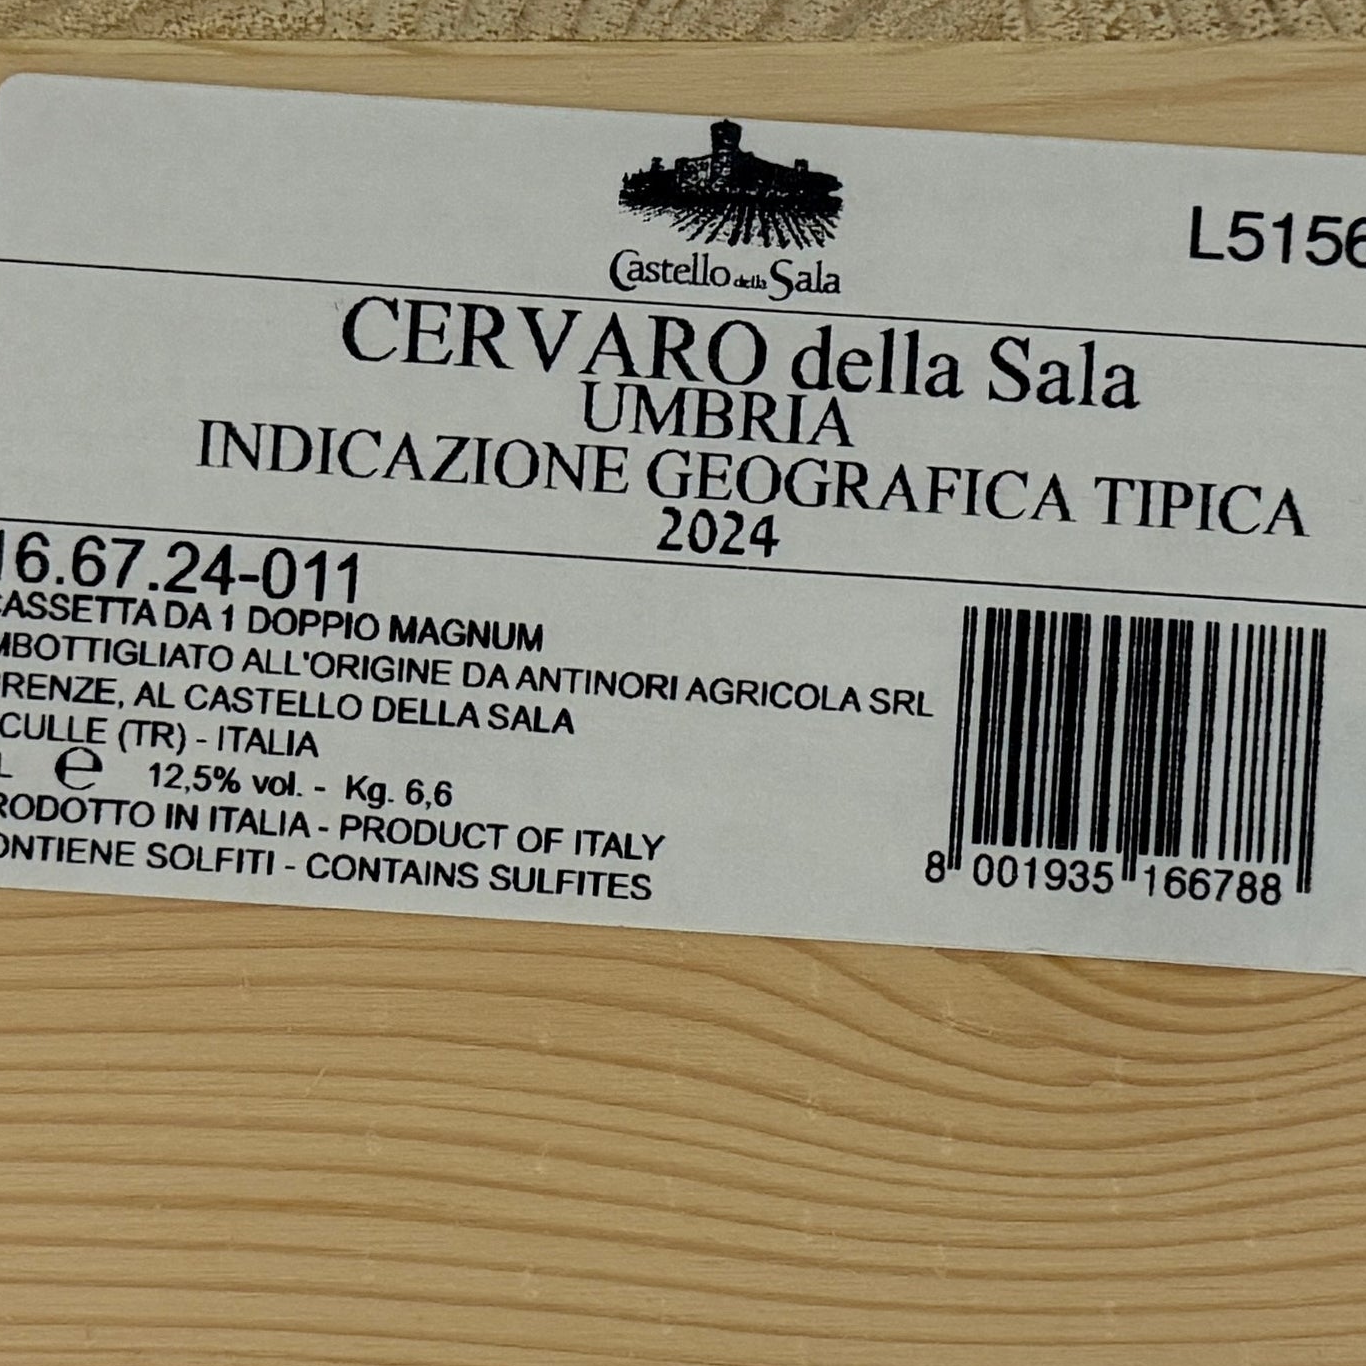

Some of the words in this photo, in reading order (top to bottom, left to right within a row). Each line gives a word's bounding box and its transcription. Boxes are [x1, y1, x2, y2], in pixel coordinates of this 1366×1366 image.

[609, 248, 732, 292] Castello
[767, 258, 841, 302] Sala
[341, 295, 768, 386] CERVARO
[791, 324, 965, 399] della
[988, 335, 1141, 410] Sala
[580, 380, 855, 448] UMBRIA
[196, 419, 629, 494] INDICAZIONE
[646, 448, 1077, 523] GEOGRAFICA
[1094, 476, 1310, 538] TIPICA
[656, 505, 781, 558] 2024
[164, 599, 213, 631] DA
[221, 603, 234, 632] 1
[247, 605, 380, 642] DOPPIO
[388, 614, 544, 653] MAGNUM
[133, 680, 176, 709] AL
[183, 683, 363, 721] CASTELLO
[372, 695, 481, 729] DELLA
[487, 702, 575, 735] SALA
[241, 647, 453, 686] ALL'ORIGINE
[462, 661, 510, 690] DA
[515, 665, 679, 701] ANTINORI
[684, 676, 862, 713] AGRICOLA
[868, 687, 934, 718] SRL
[117, 718, 187, 757] (TR)
[217, 725, 320, 758] ITALIA
[148, 761, 242, 794] 12,5%
[251, 770, 303, 797] vol.
[345, 774, 395, 810] Kg.
[405, 778, 453, 811] 6,6
[165, 802, 199, 831] IN
[209, 805, 311, 839] ITALIA
[339, 813, 509, 851] PRODUCT
[516, 825, 564, 854] OF
[574, 829, 666, 861] ITALY
[146, 841, 275, 876] SOLFITI
[305, 851, 479, 889] CONTAINS
[488, 863, 653, 901] SULFITES
[924, 849, 946, 884] 8
[972, 852, 1114, 895] 001935
[1143, 864, 1282, 906] 166788
